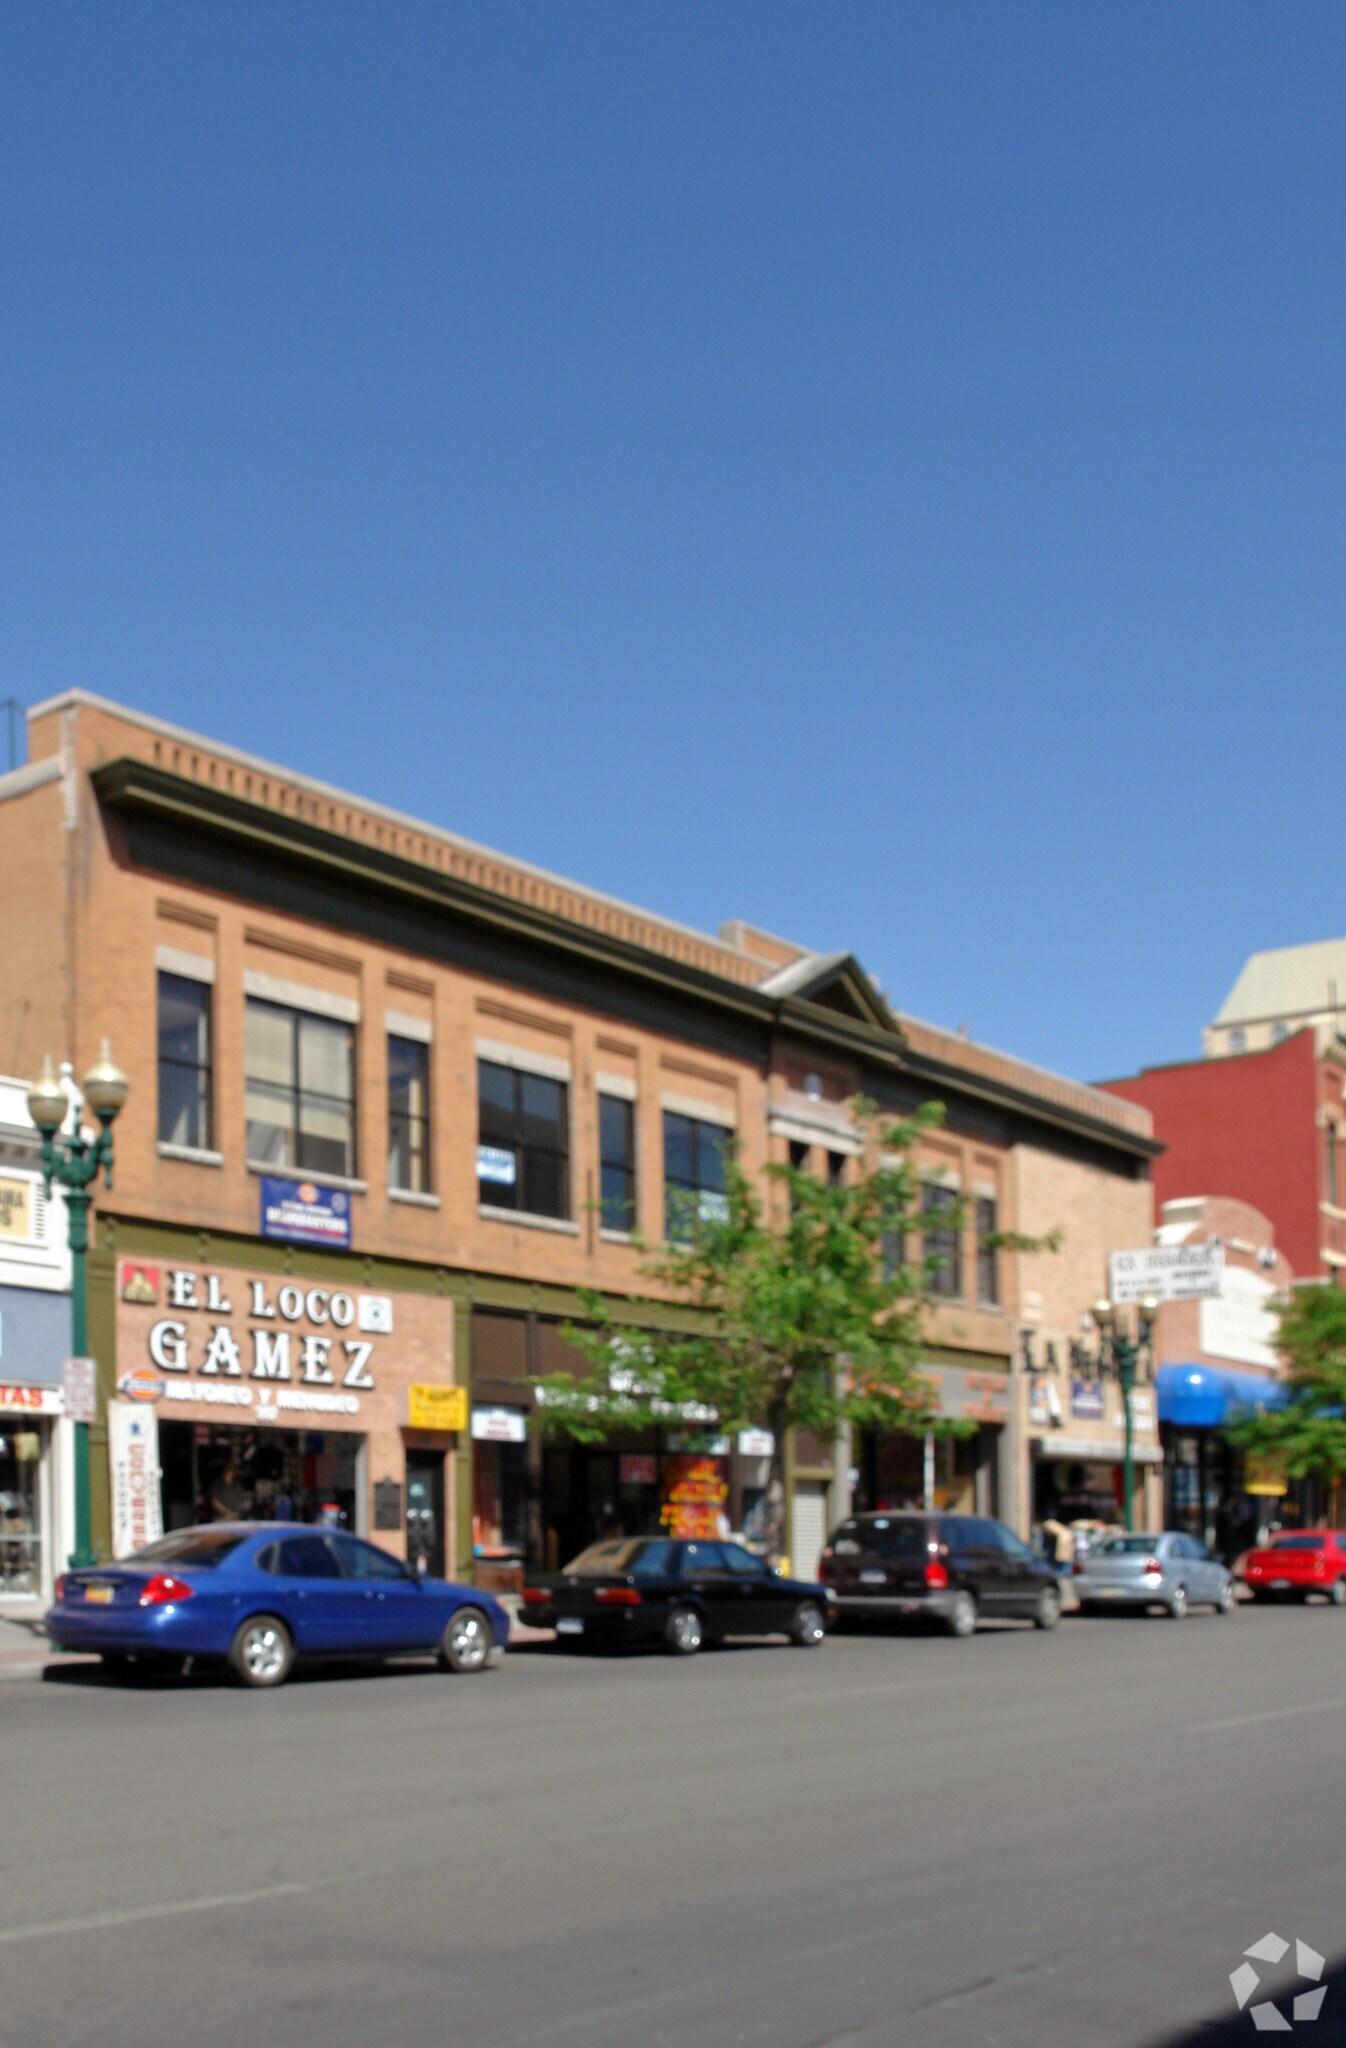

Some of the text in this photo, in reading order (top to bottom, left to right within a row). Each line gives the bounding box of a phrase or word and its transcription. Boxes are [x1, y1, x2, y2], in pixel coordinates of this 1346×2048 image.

[169, 1270, 231, 1313] EL
[250, 1281, 355, 1328] LOCO
[149, 1319, 375, 1388] GAMEZ
